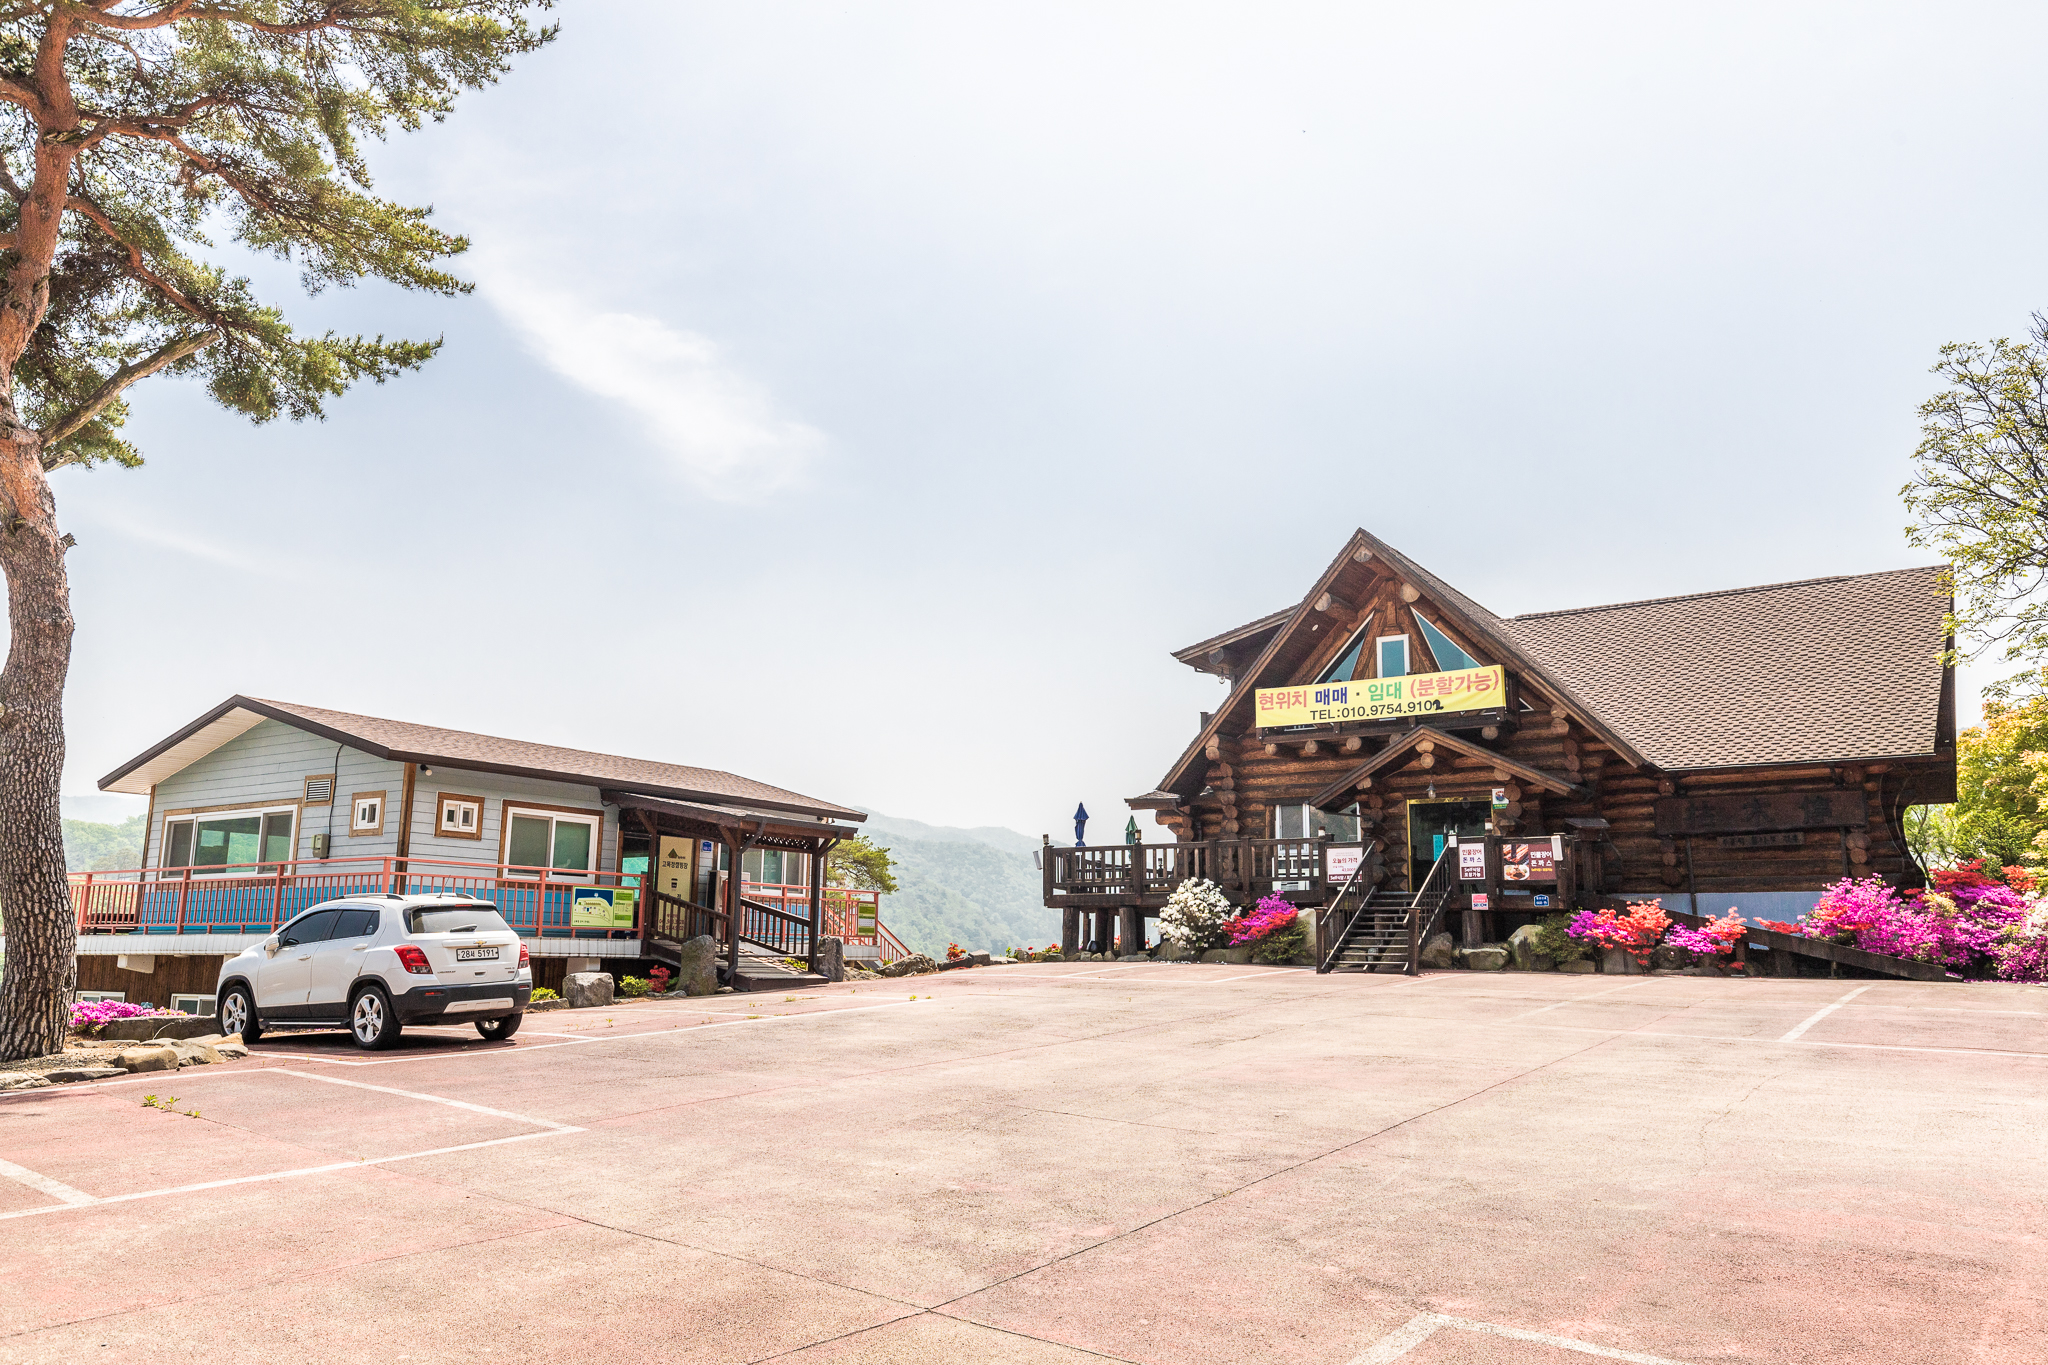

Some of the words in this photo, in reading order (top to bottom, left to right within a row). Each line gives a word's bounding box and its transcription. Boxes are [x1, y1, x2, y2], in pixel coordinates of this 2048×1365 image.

[1258, 690, 1307, 711] 현위치
[1315, 687, 1348, 705] 매매
[1368, 681, 1402, 702] 임대
[1410, 669, 1500, 699] (분할가능)
[477, 949, 495, 957] 5191
